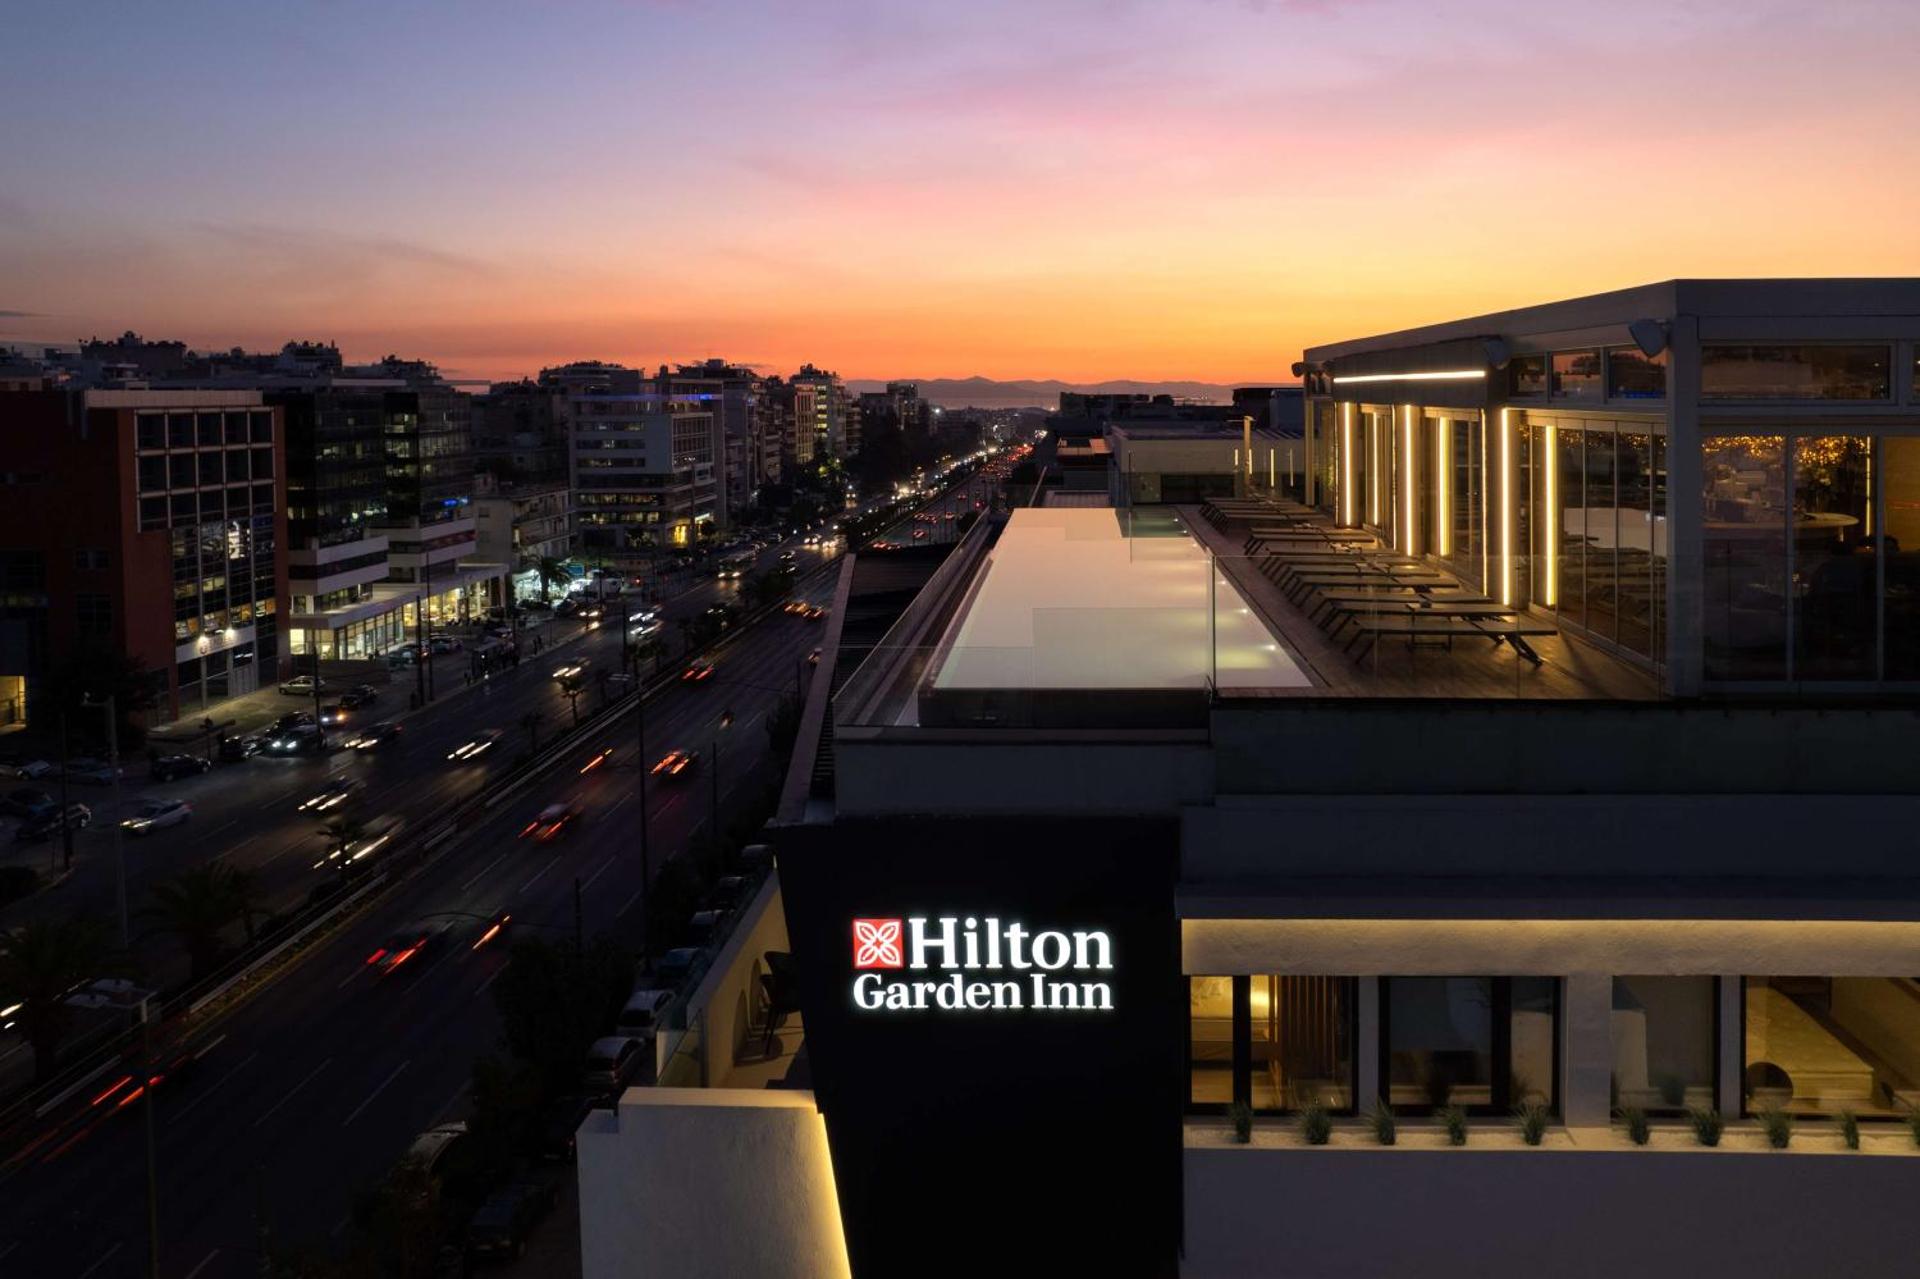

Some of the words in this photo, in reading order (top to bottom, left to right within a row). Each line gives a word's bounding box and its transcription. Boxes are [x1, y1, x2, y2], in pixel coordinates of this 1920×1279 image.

[908, 917, 1114, 970] Hilton
[853, 973, 1024, 1010] Garden
[1029, 973, 1114, 1010] Inn
